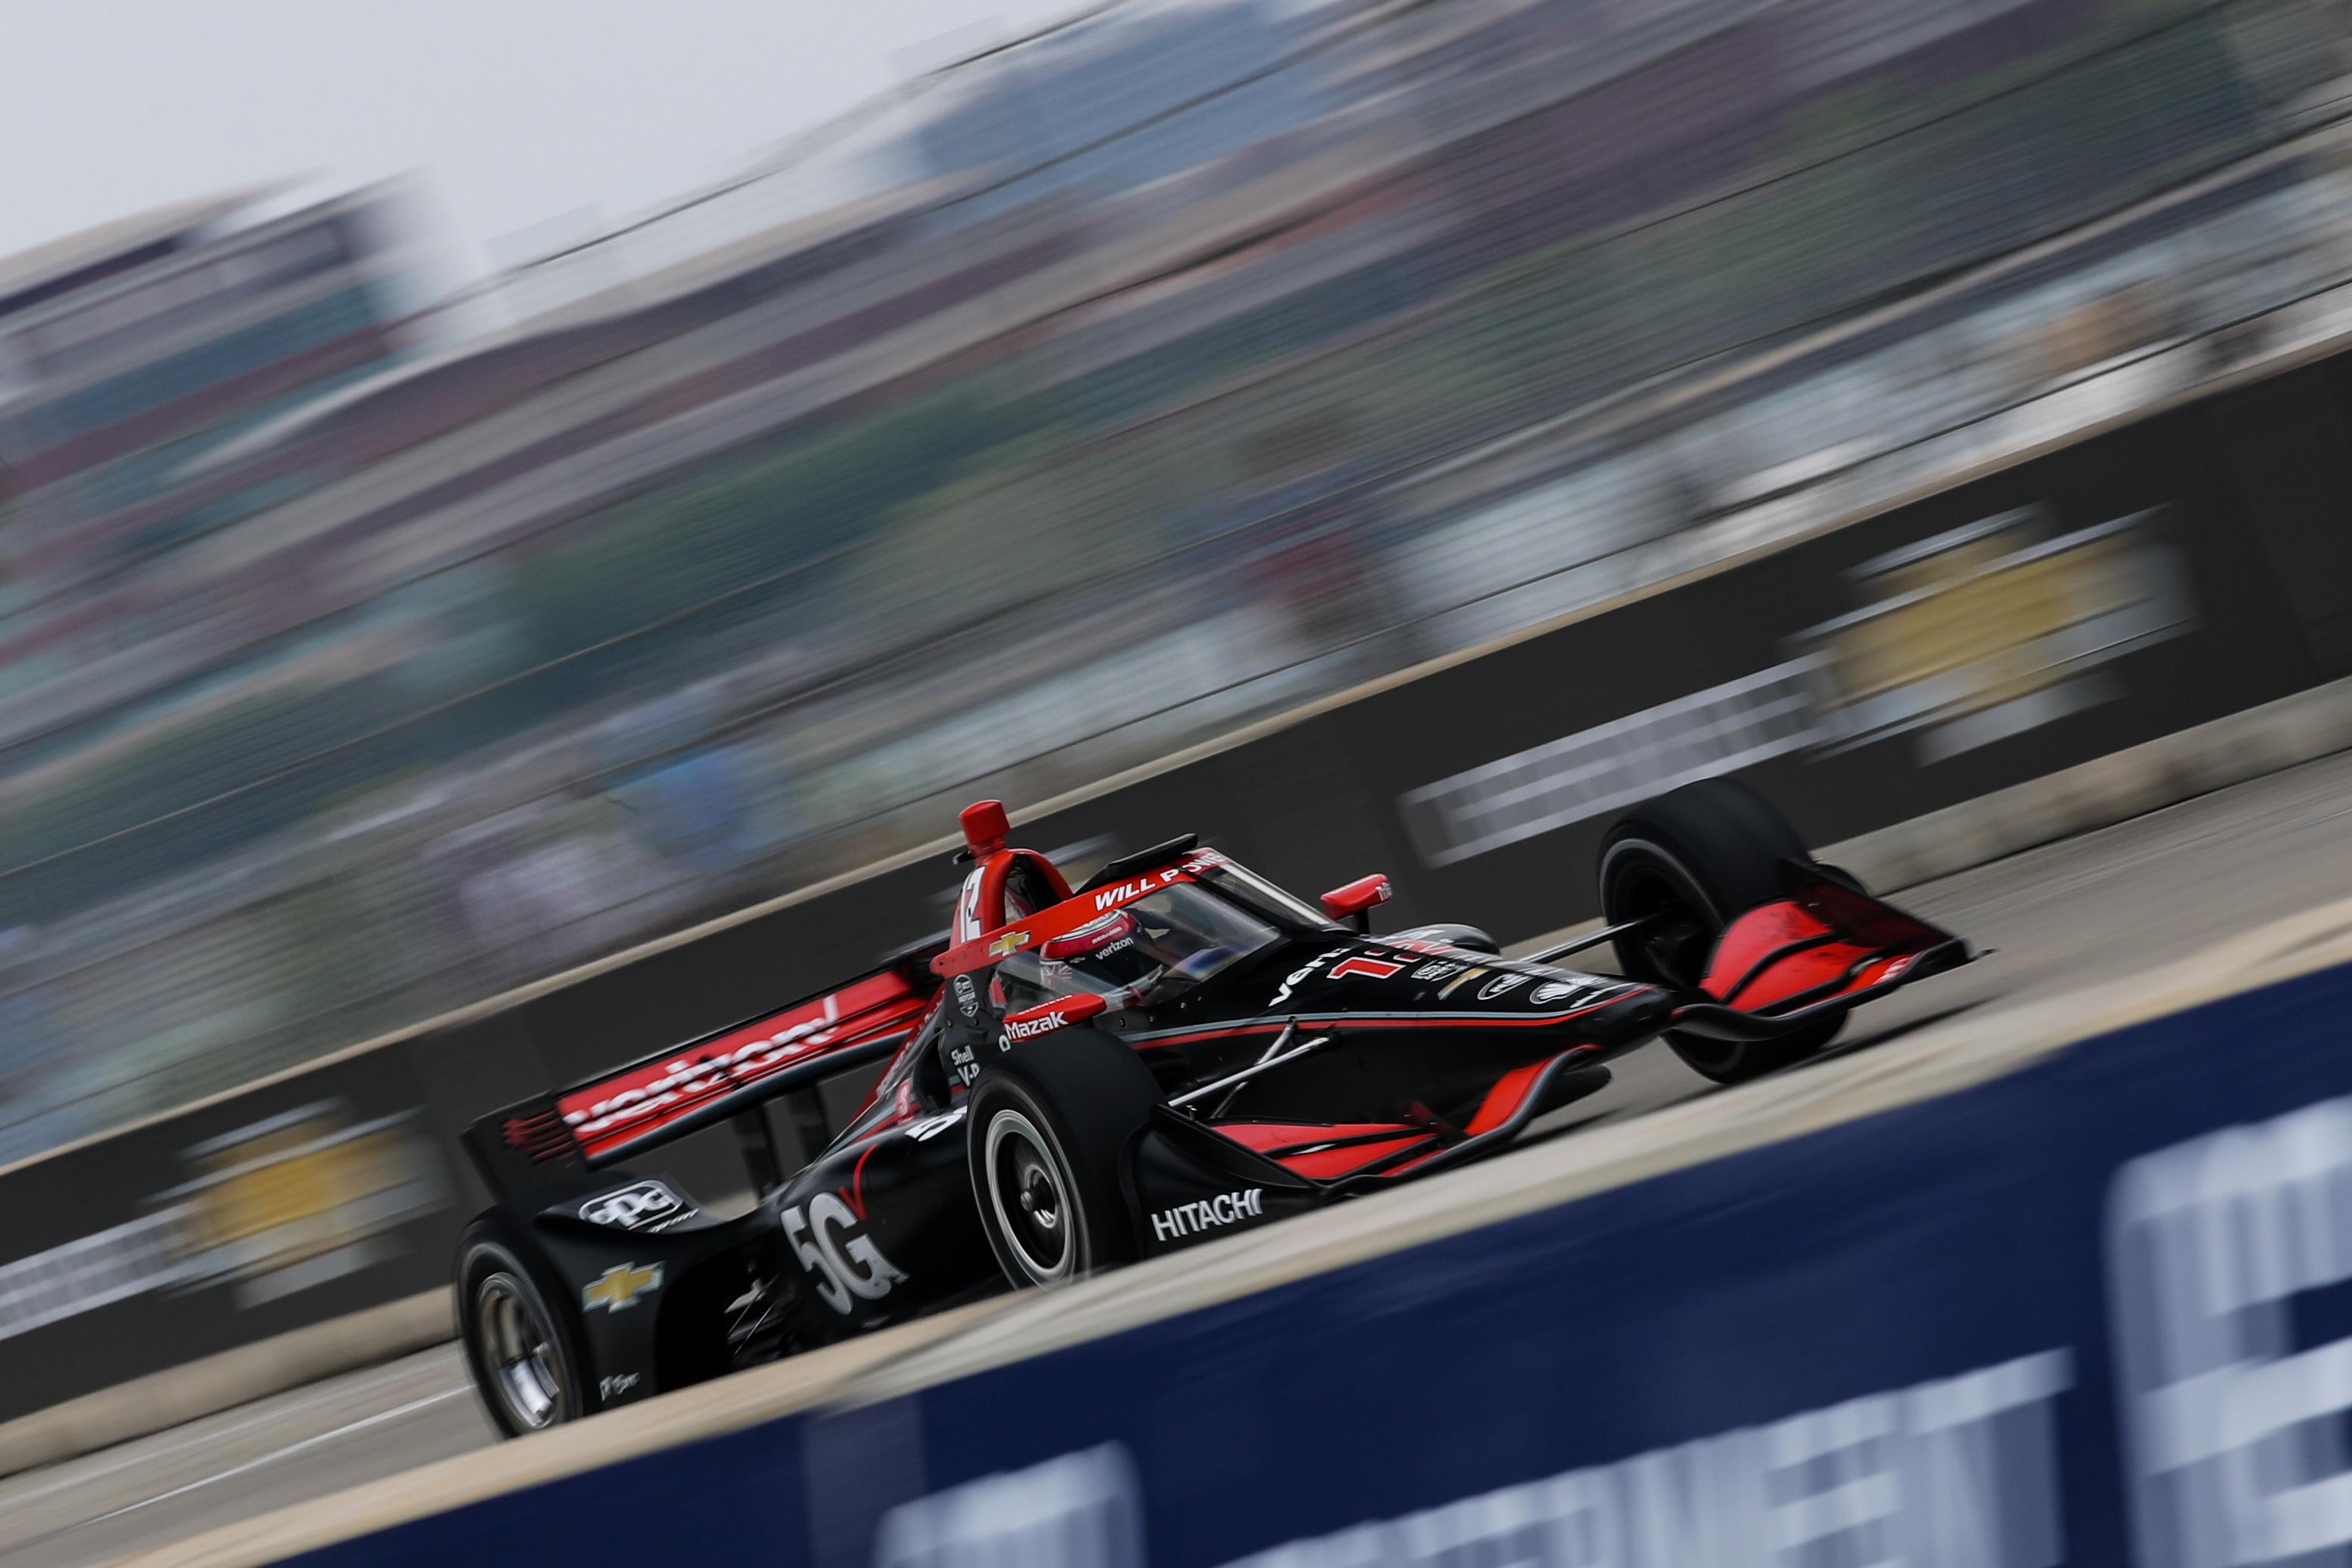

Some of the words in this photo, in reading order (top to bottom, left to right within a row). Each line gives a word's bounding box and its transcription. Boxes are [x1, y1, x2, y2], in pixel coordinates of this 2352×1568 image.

[1095, 878, 1156, 911] WILL
[1095, 937, 1134, 960] verizon
[1004, 1011, 1069, 1040] Mazak
[951, 1045, 974, 1066] Shell
[1150, 1188, 1264, 1241] HITACHI
[780, 1192, 910, 1315] 5G
